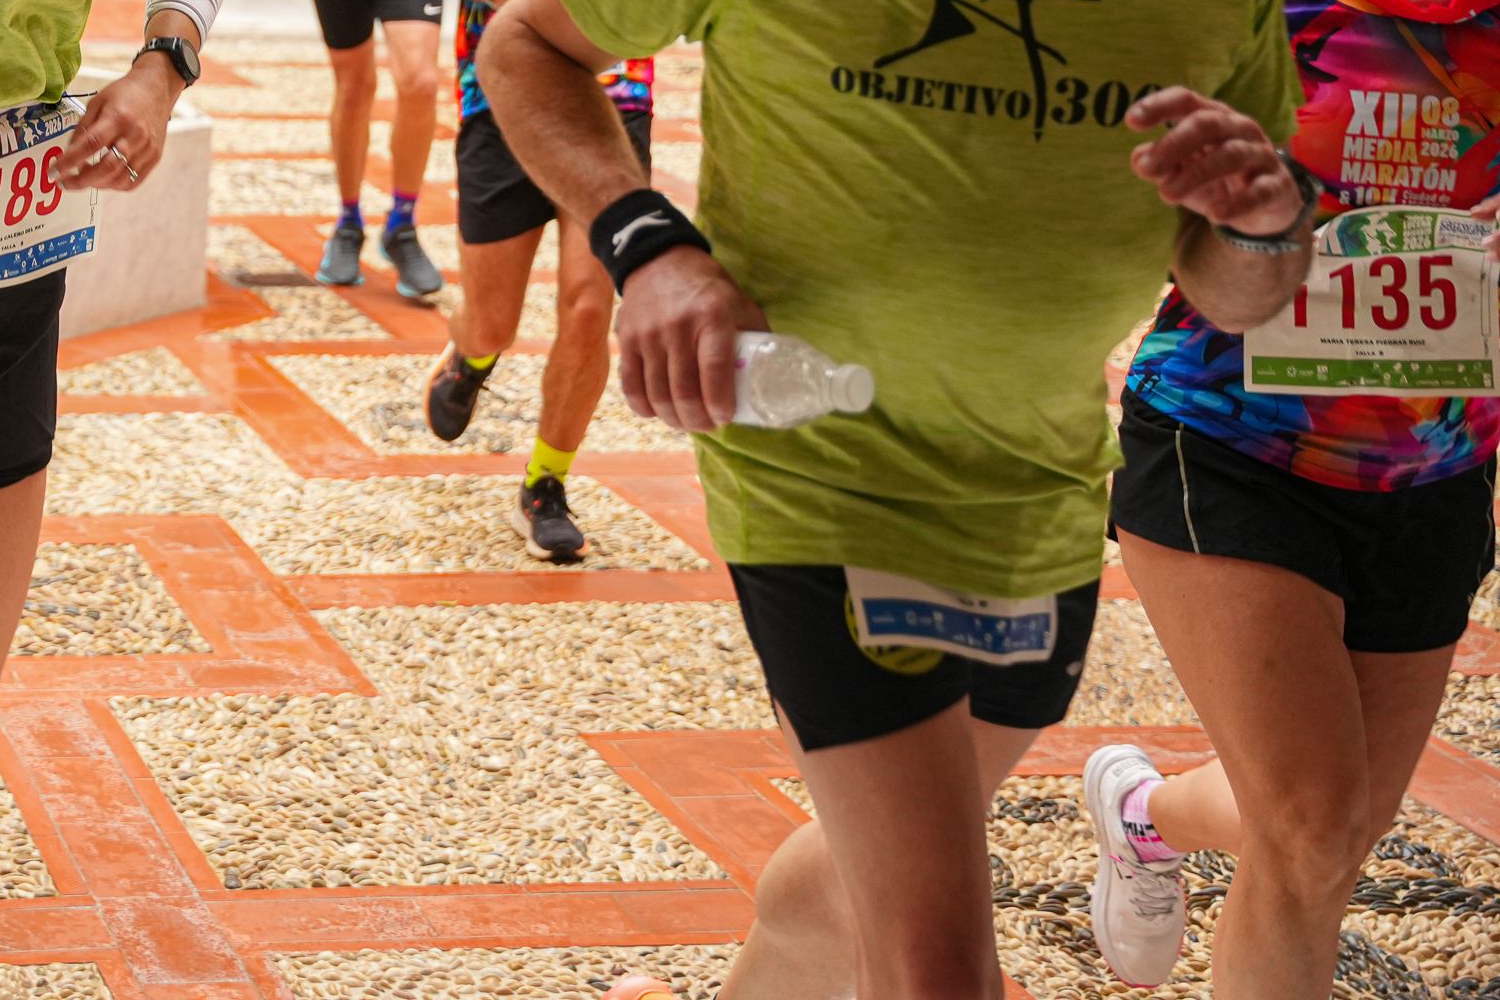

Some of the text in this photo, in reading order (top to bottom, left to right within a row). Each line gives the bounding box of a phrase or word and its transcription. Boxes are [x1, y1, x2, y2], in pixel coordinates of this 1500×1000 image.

[830, 65, 1032, 121] OBJETIVO
[1346, 89, 1417, 139] XII
[1421, 95, 1460, 127] 08
[1420, 127, 1460, 141] MARZO
[1420, 141, 1459, 159] 2026
[1343, 136, 1419, 165] MEDIA
[1293, 254, 1457, 331] 1135
